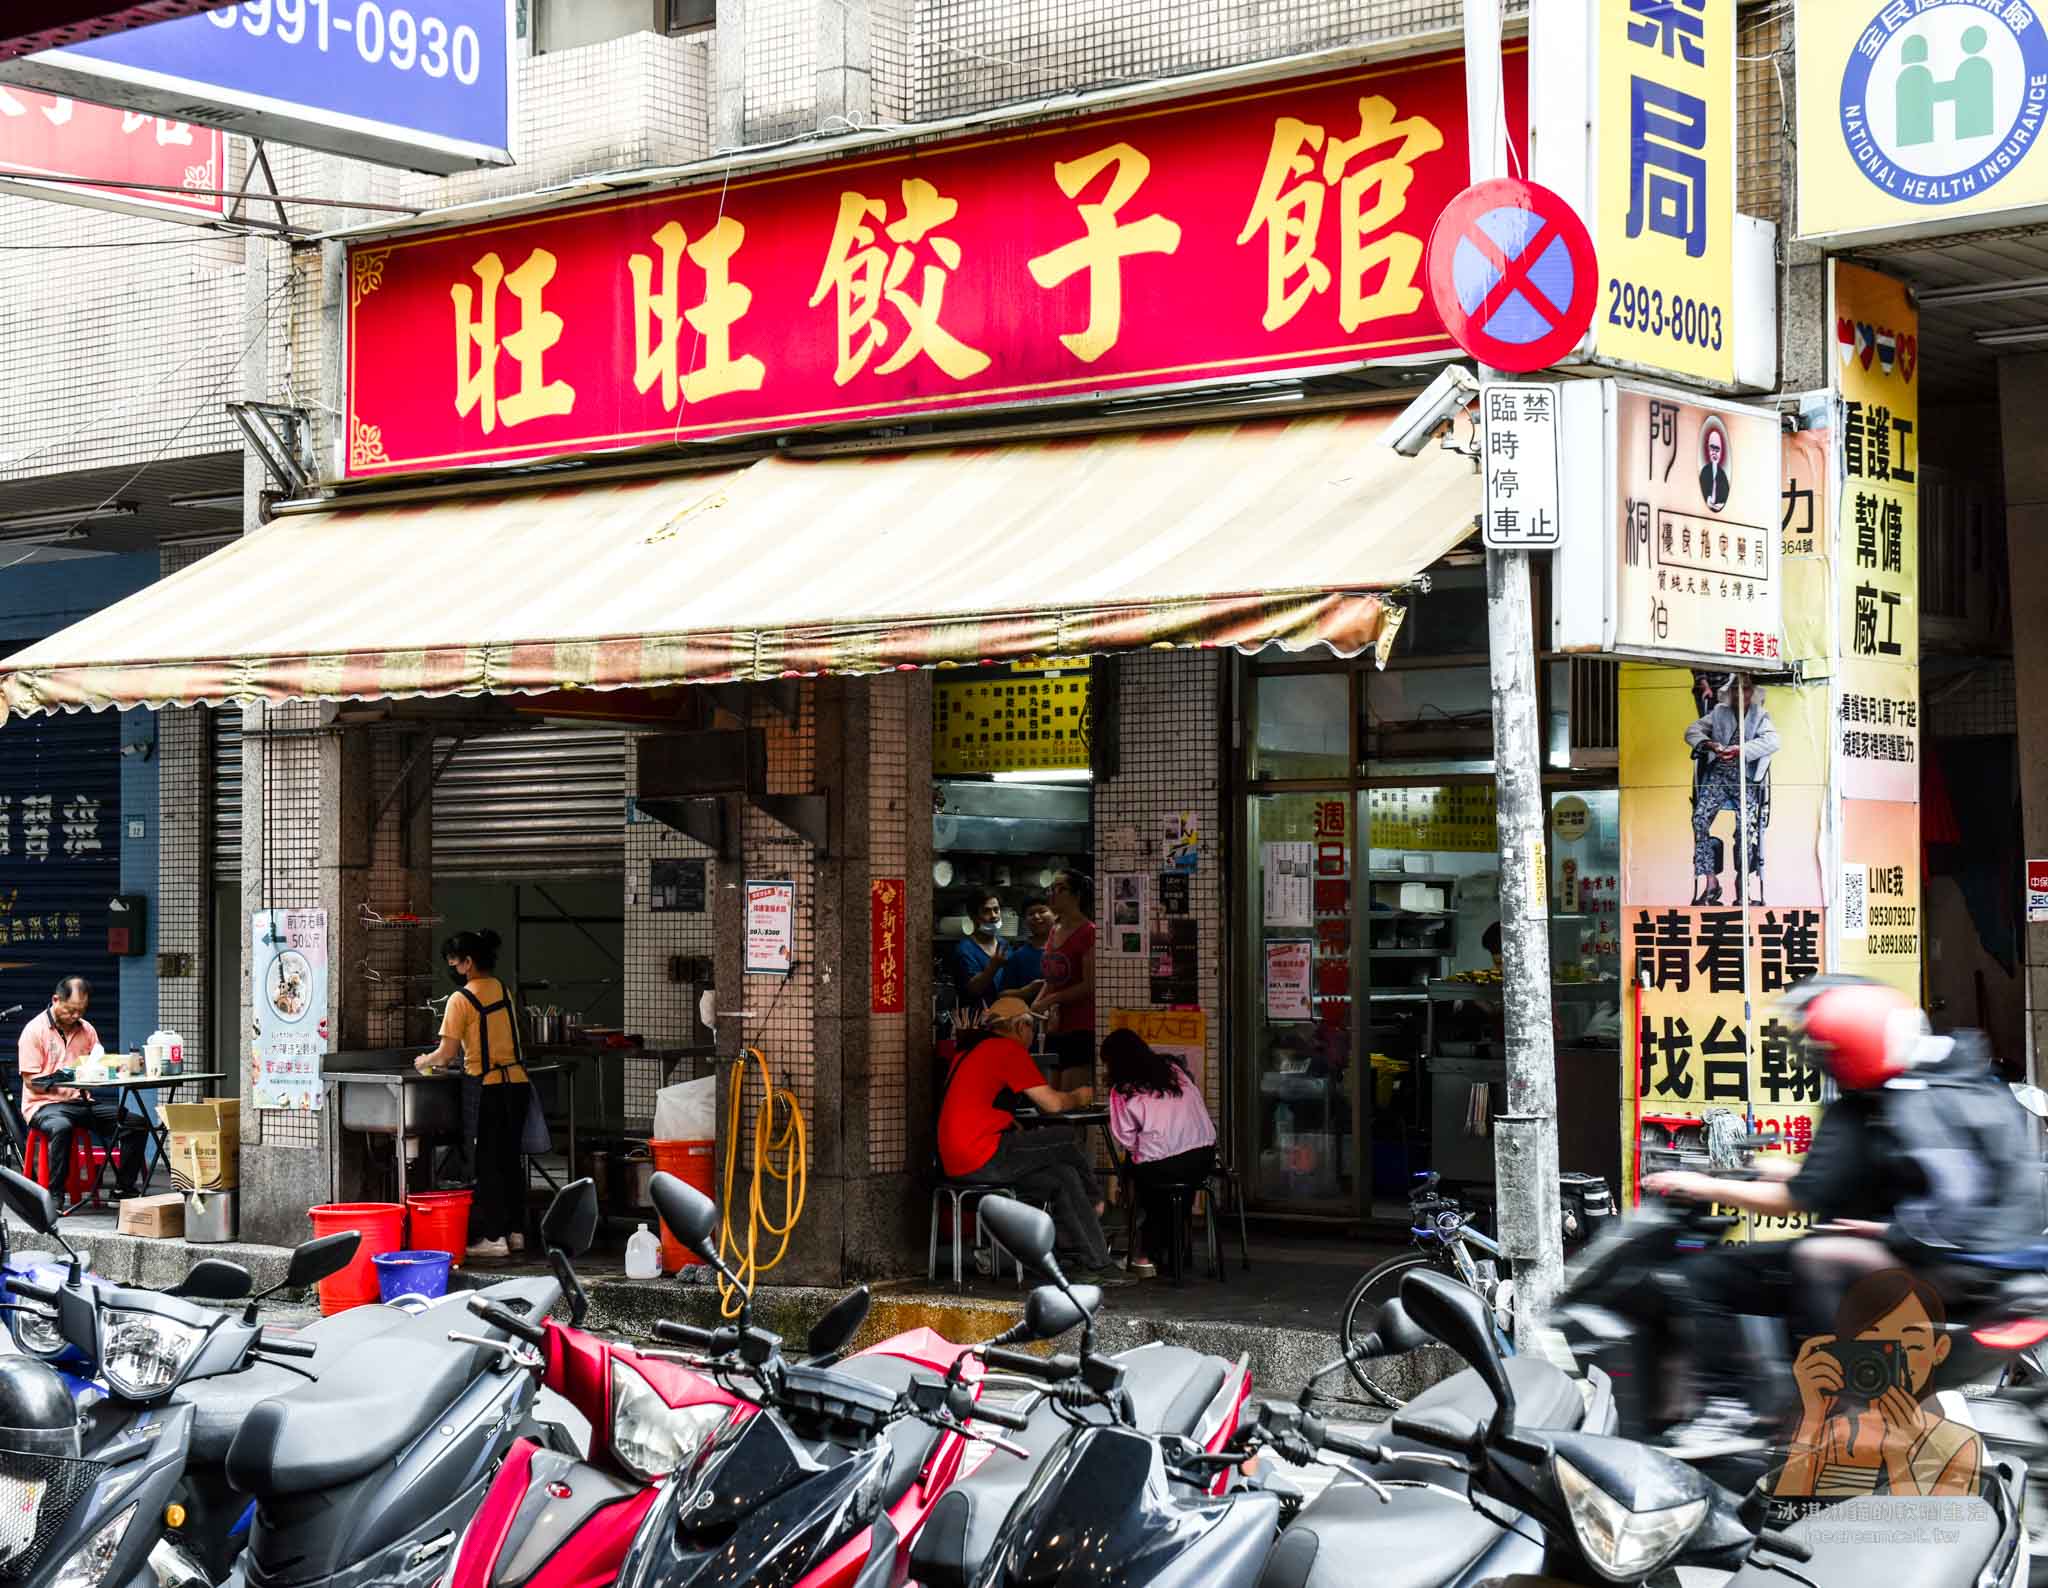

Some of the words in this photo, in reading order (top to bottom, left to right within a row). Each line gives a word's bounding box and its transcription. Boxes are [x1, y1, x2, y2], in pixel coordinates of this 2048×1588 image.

[1845, 104, 1897, 189] NATIONAL
[1901, 173, 1976, 199] HEALTH
[1978, 73, 2047, 183] INSURANCE
[450, 95, 1445, 435] 旺旺餃子館
[1608, 278, 1722, 352] 2993-8003
[1844, 400, 1915, 484] 看護工
[1625, 400, 1682, 644] 阿桐伯
[1854, 491, 1903, 573] 幫傭
[1725, 628, 1779, 658] 國安藥妝
[1853, 580, 1902, 657] 廠工
[1869, 865, 1904, 897] LINE我
[1869, 906, 1917, 926] 0953079317
[879, 909, 897, 1007] 新年快樂
[1632, 909, 1820, 994] 請看護
[1868, 934, 1918, 954] 02-89918887
